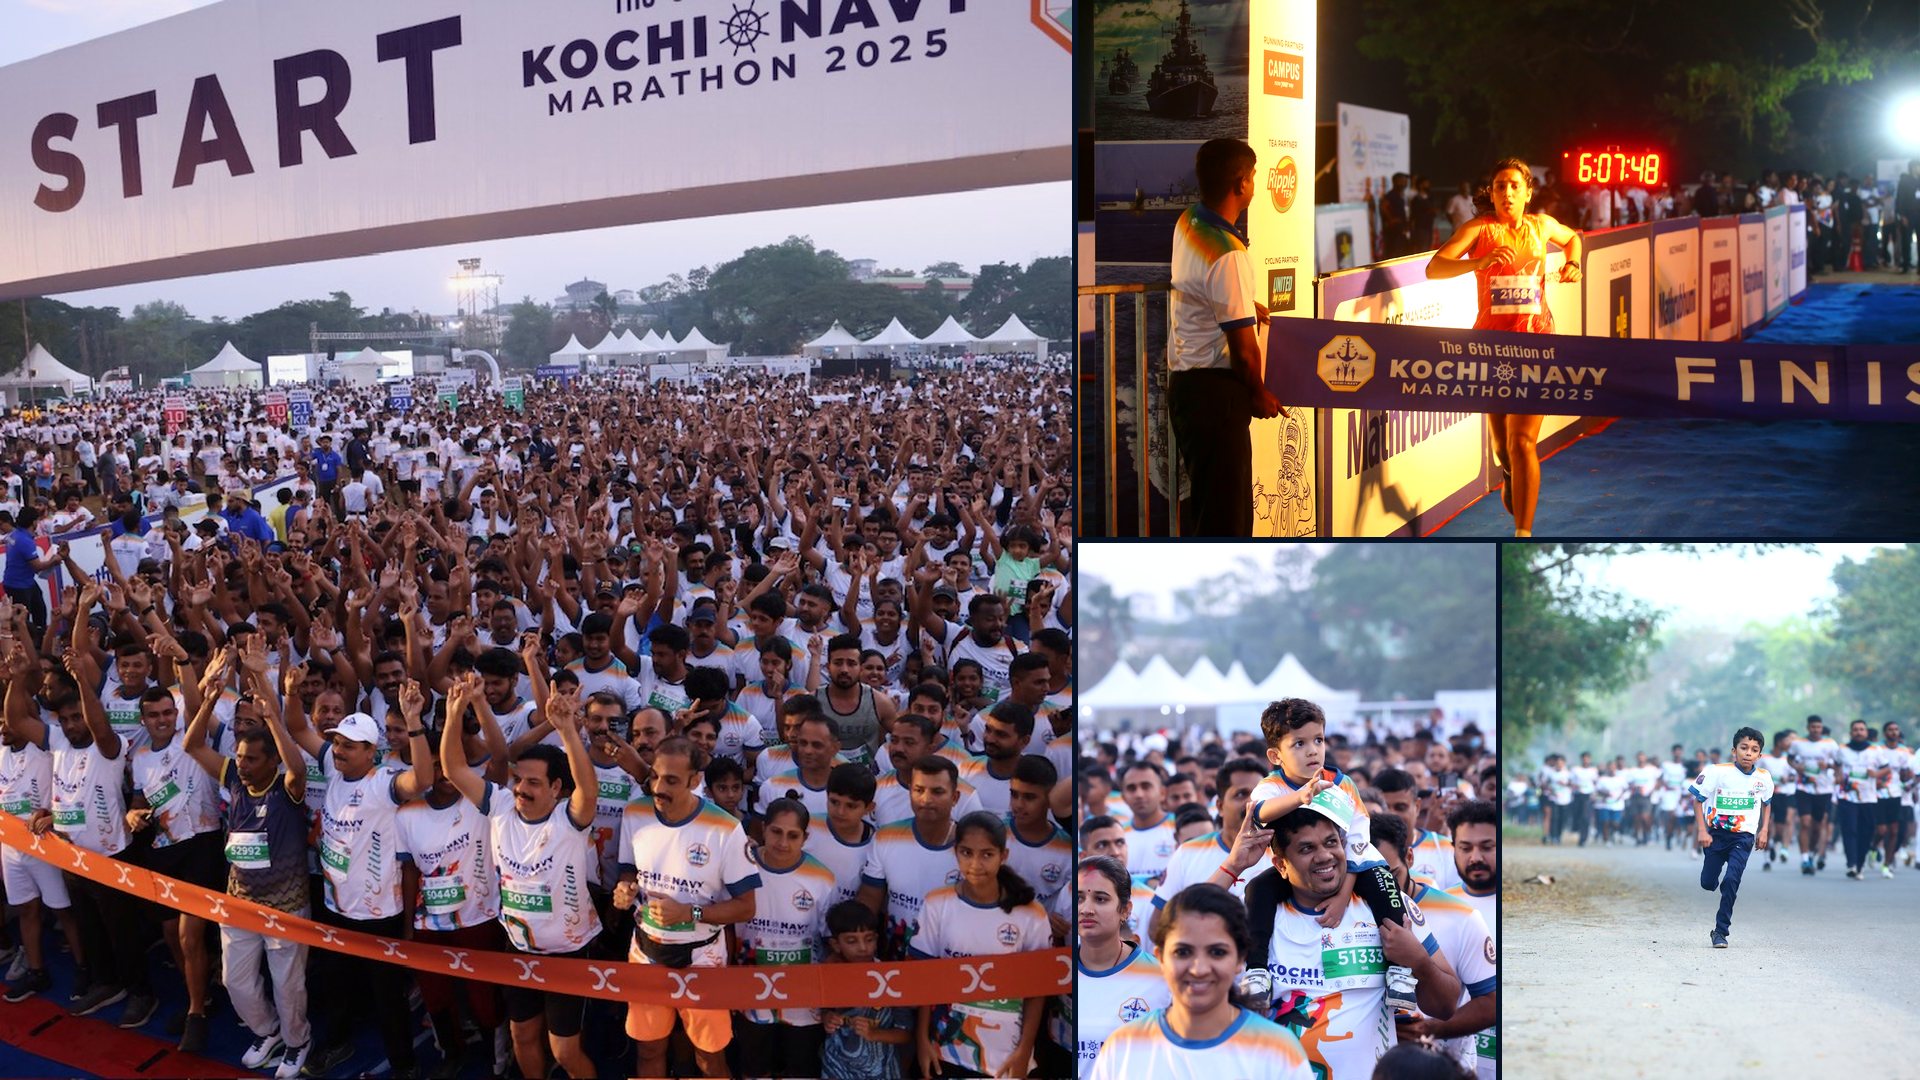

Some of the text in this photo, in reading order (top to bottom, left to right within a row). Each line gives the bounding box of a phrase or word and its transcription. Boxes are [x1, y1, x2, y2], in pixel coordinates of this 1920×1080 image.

[522, 15, 708, 88] KOCHI
[547, 28, 950, 117] MARATHON 2025
[1268, 58, 1300, 81] CAMPUS
[31, 15, 463, 213] START
[1268, 138, 1297, 149] TEA PARTNER
[1578, 152, 1660, 185] 6:07:48
[1267, 168, 1296, 194] Ripple
[1264, 255, 1299, 265] CYCLING PARTNER
[1439, 340, 1556, 360] The 6th Edition of
[1389, 358, 1608, 386] KOCHI NAVY
[1402, 382, 1594, 401] MARATHON 2025
[293, 403, 309, 415] 21
[393, 398, 409, 409] 21
[168, 411, 184, 423] 10
[269, 405, 286, 417] 10
[293, 415, 309, 426] KM
[1722, 797, 1749, 806] 52463
[231, 846, 261, 856] 52992
[672, 876, 705, 889] NAVY
[426, 888, 458, 900] 50449
[507, 892, 545, 907] 50342
[766, 951, 802, 962] 51701
[1338, 948, 1384, 966] 51333
[1268, 963, 1319, 979] KOCHI
